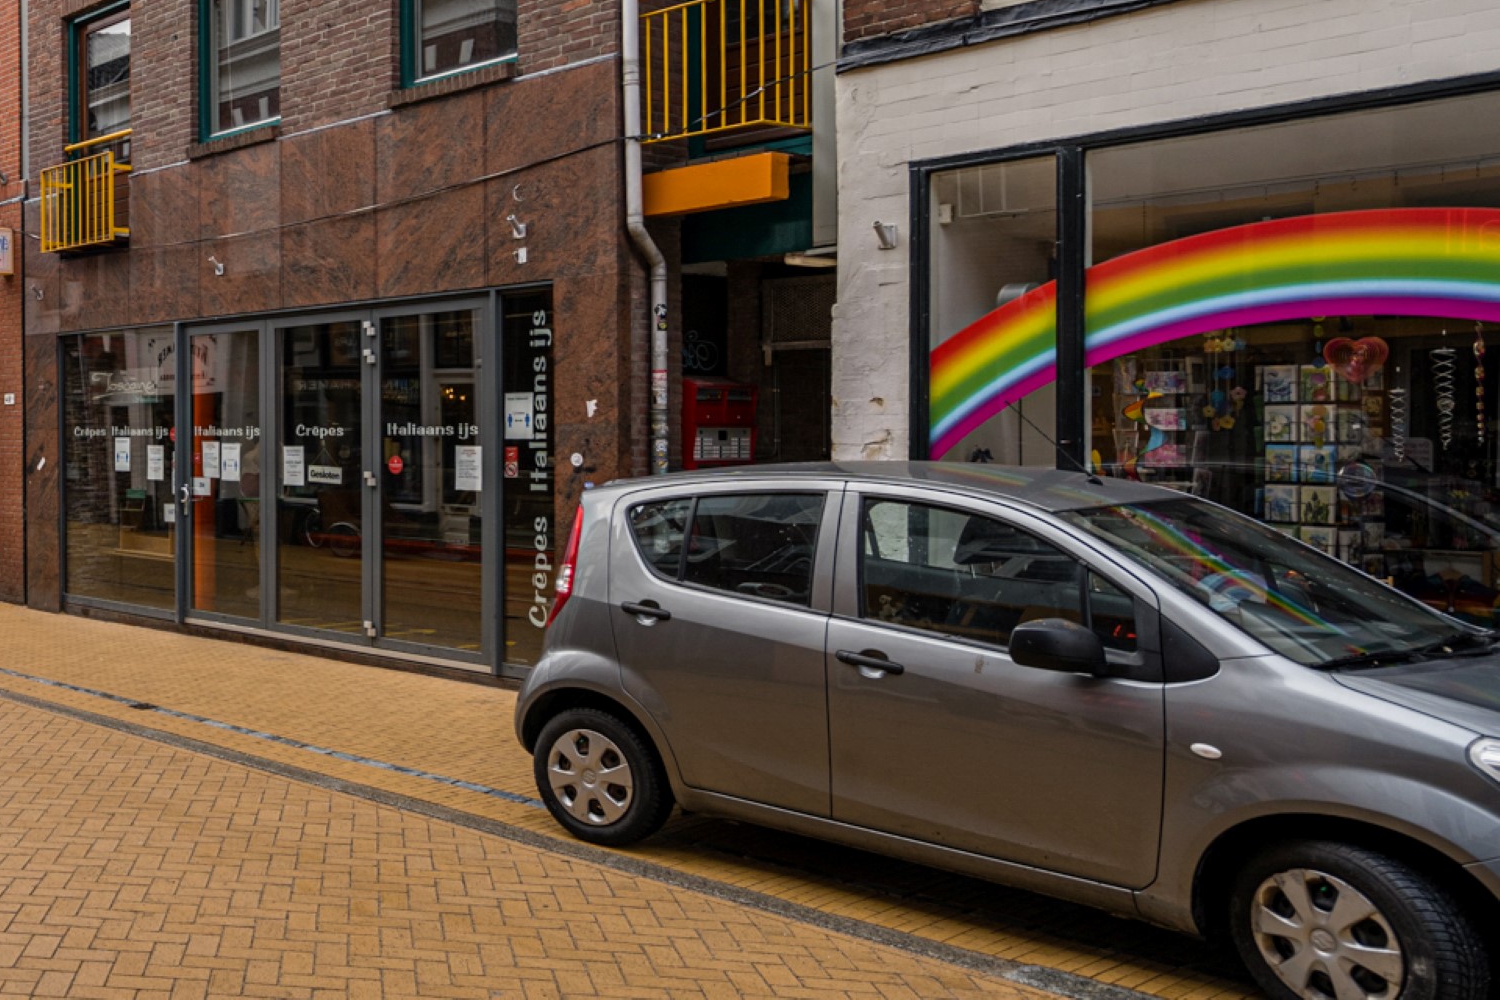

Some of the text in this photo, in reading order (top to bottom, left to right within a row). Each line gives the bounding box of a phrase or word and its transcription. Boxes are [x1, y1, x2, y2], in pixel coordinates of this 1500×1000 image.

[529, 309, 552, 347] ijs
[194, 424, 260, 440] Italiaans ijs
[386, 422, 455, 436] Italiaans
[458, 422, 479, 440] ijs
[528, 355, 548, 491] Italiaans
[111, 425, 153, 437] Italiaans
[155, 425, 169, 440] ijs
